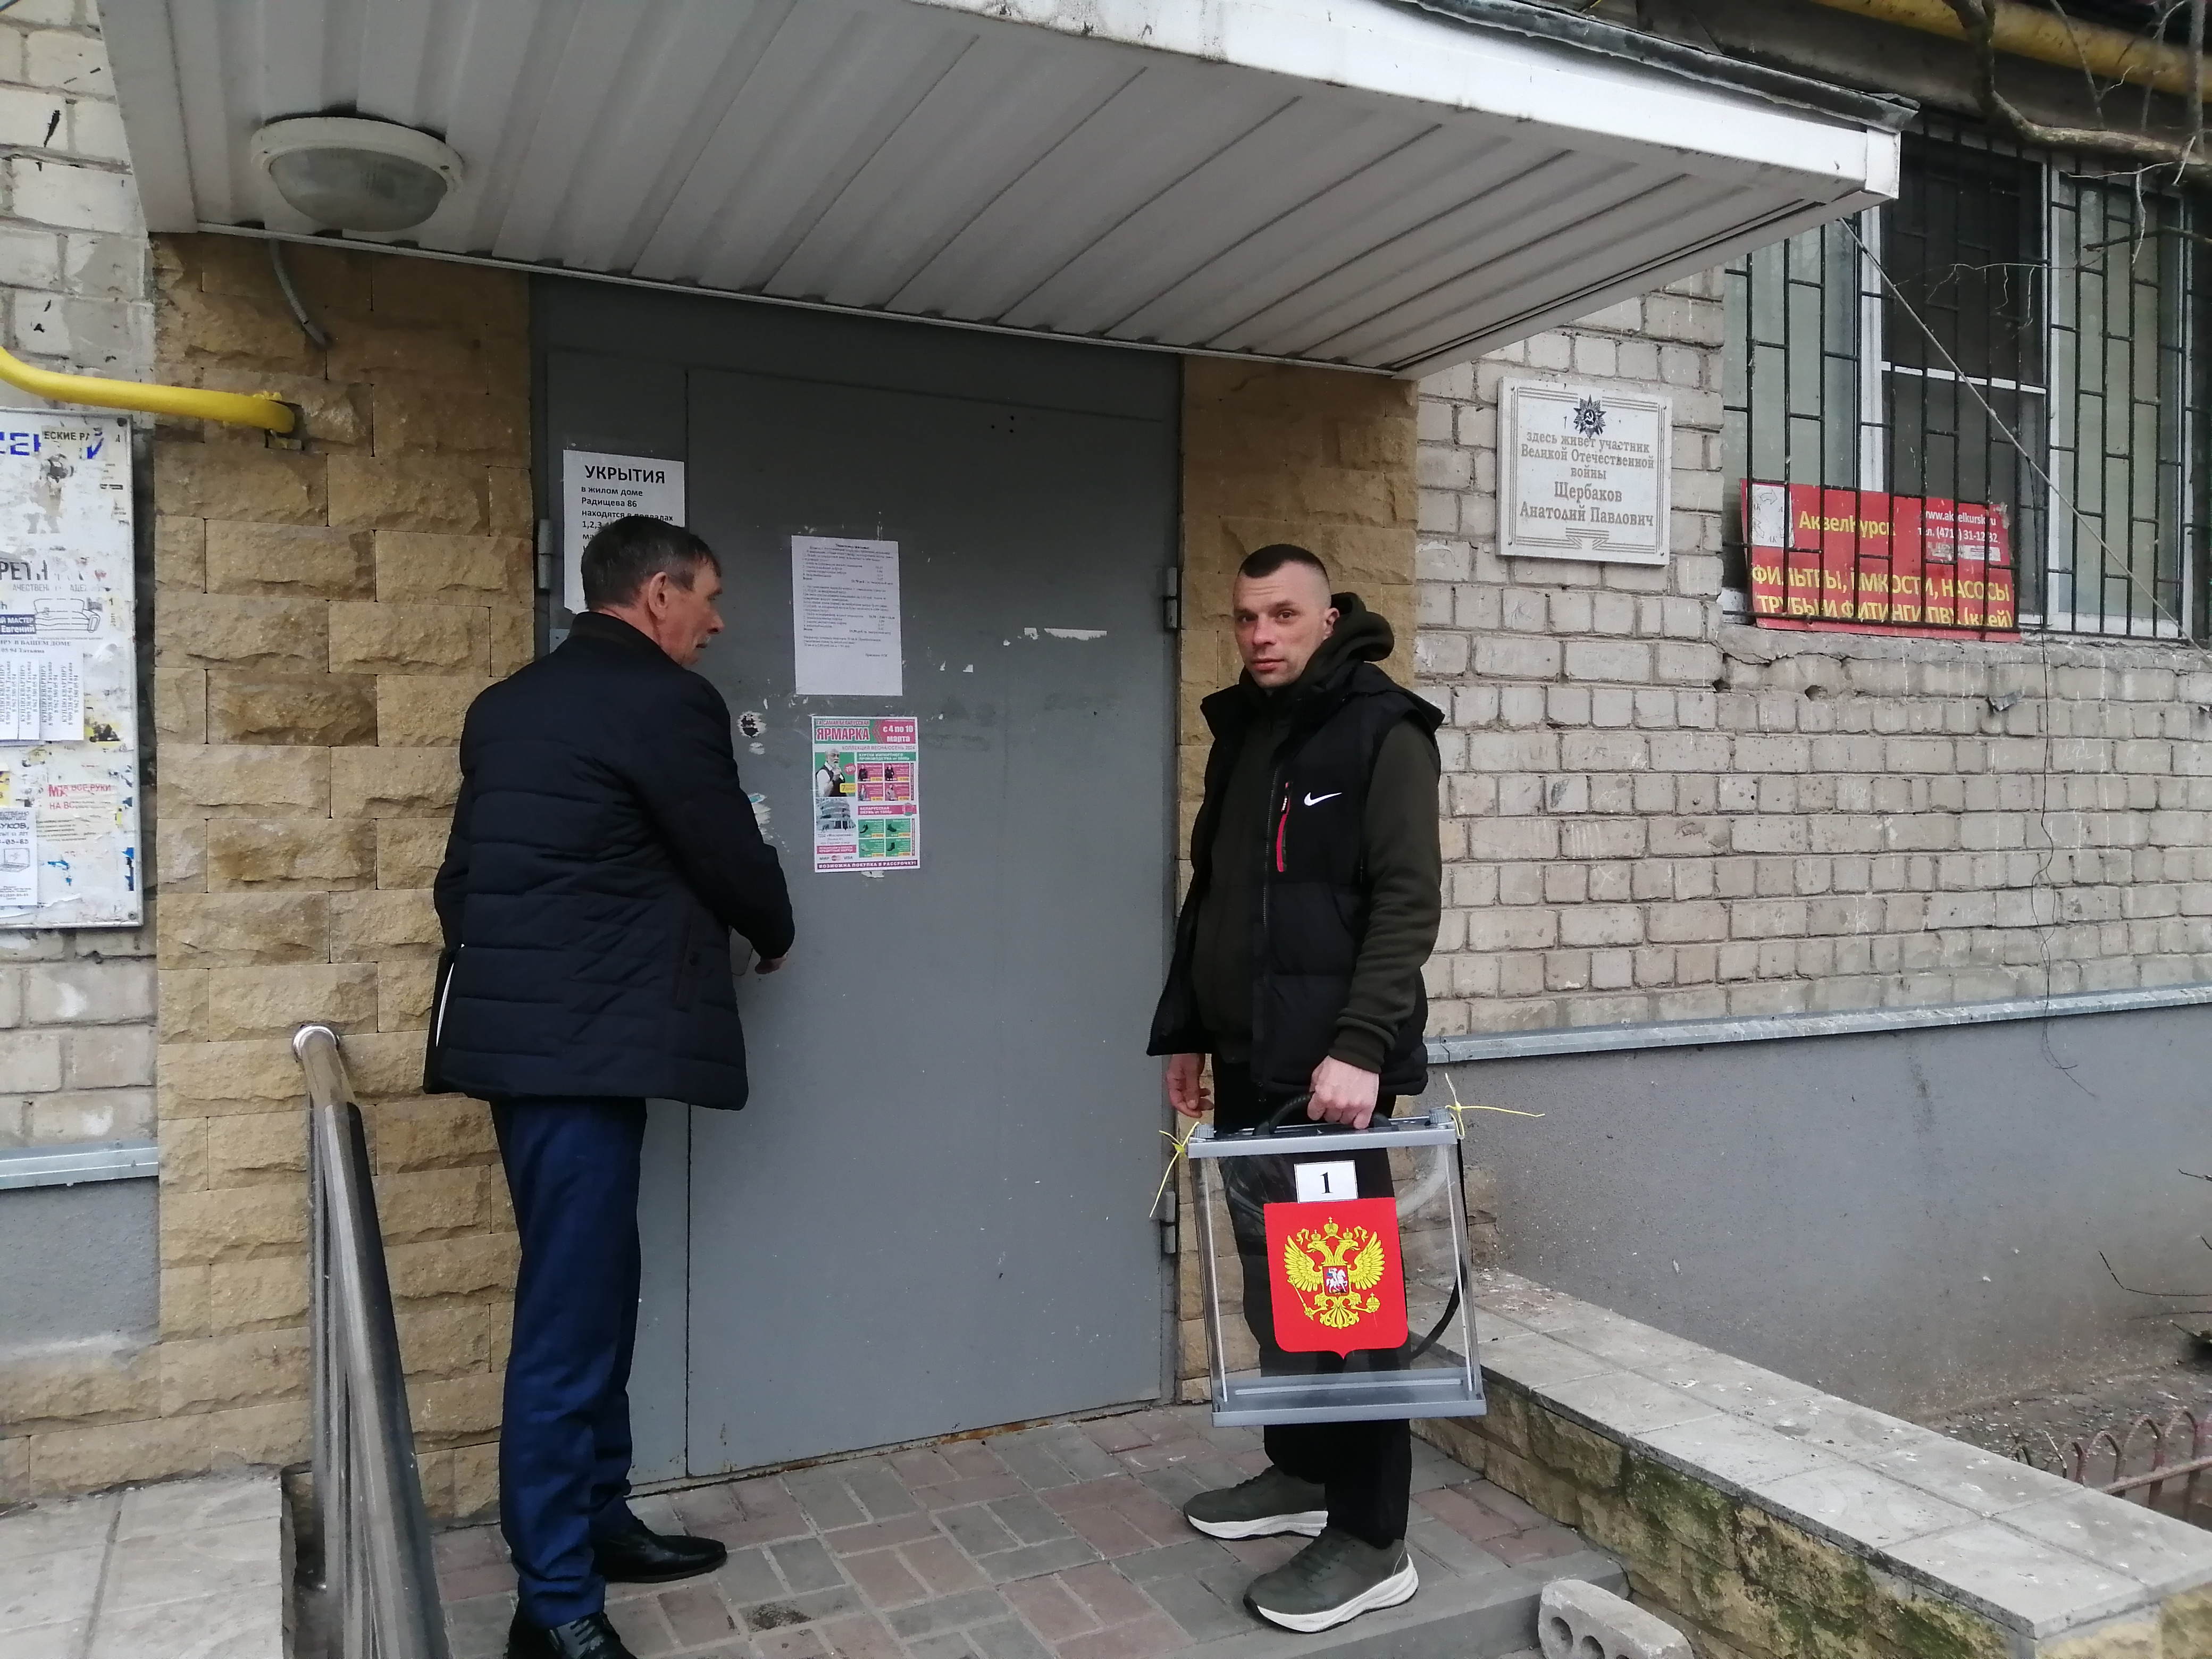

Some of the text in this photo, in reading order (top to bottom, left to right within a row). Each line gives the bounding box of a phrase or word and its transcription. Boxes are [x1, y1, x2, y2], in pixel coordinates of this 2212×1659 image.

[44, 431, 77, 440] ЕСКИЕ
[1561, 434, 1596, 448] живет
[1599, 439, 1650, 454] участник
[1521, 443, 1654, 469] Великой Отечественной
[585, 465, 665, 484] УКРЫТИЯ
[1570, 465, 1607, 480] войны
[1554, 481, 1622, 504] Щербаков
[582, 497, 625, 507] Радищева
[582, 510, 625, 519] находятся
[1520, 501, 1654, 526] Анатолий Павлович
[1921, 510, 1997, 526] ww.akelkurskru
[1937, 526, 1962, 541] (471)
[1964, 531, 1998, 543] 31-1232
[1941, 579, 2010, 601] НАСОСЫ
[1823, 599, 1838, 617] И
[1, 624, 35, 633] Евгений
[816, 727, 870, 741] ЯРМАРКА
[1320, 1172, 1333, 1194] 1
